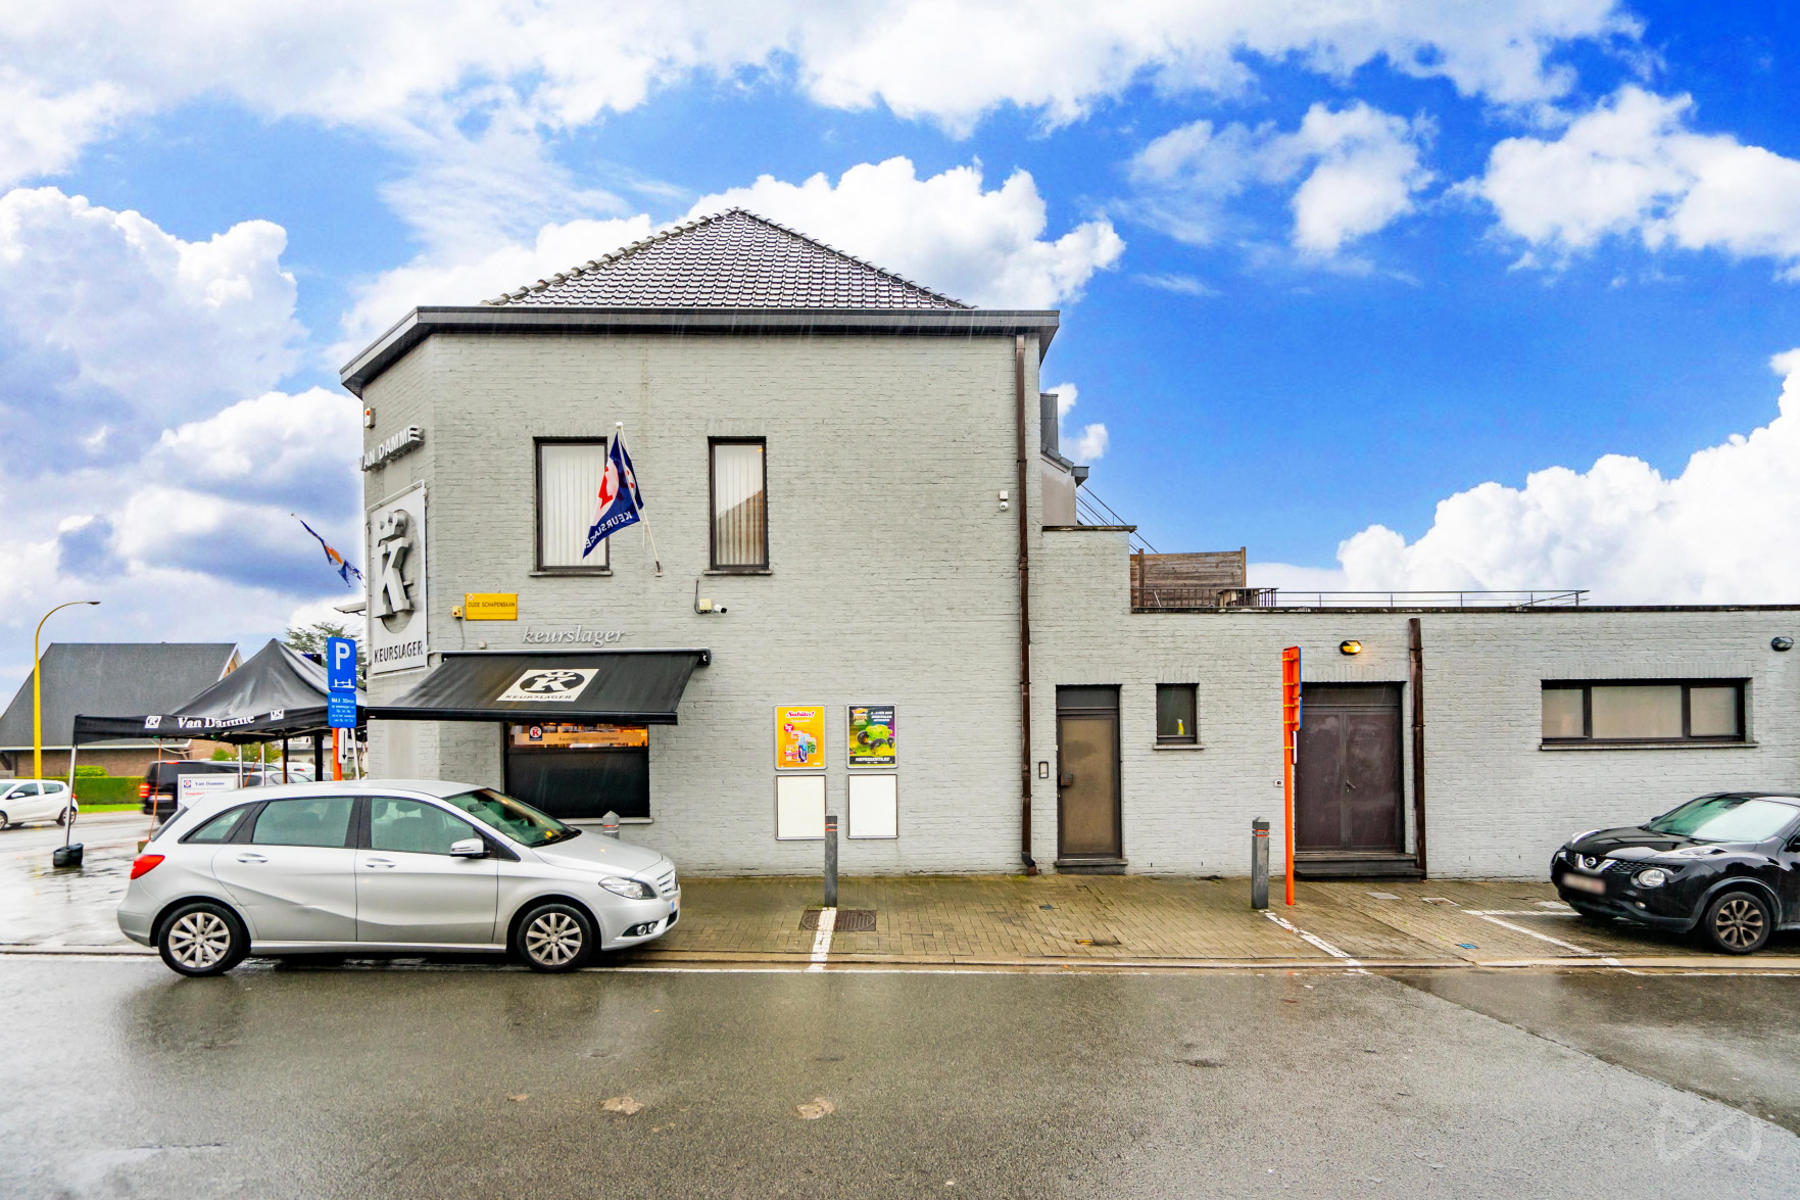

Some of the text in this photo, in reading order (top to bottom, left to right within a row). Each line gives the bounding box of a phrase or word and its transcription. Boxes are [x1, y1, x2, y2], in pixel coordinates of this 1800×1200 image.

[379, 425, 422, 460] DAMME
[522, 624, 625, 648] keurslager
[335, 642, 350, 670] P
[374, 640, 424, 663] KEURSLAGER
[178, 715, 255, 728] Van Damme
